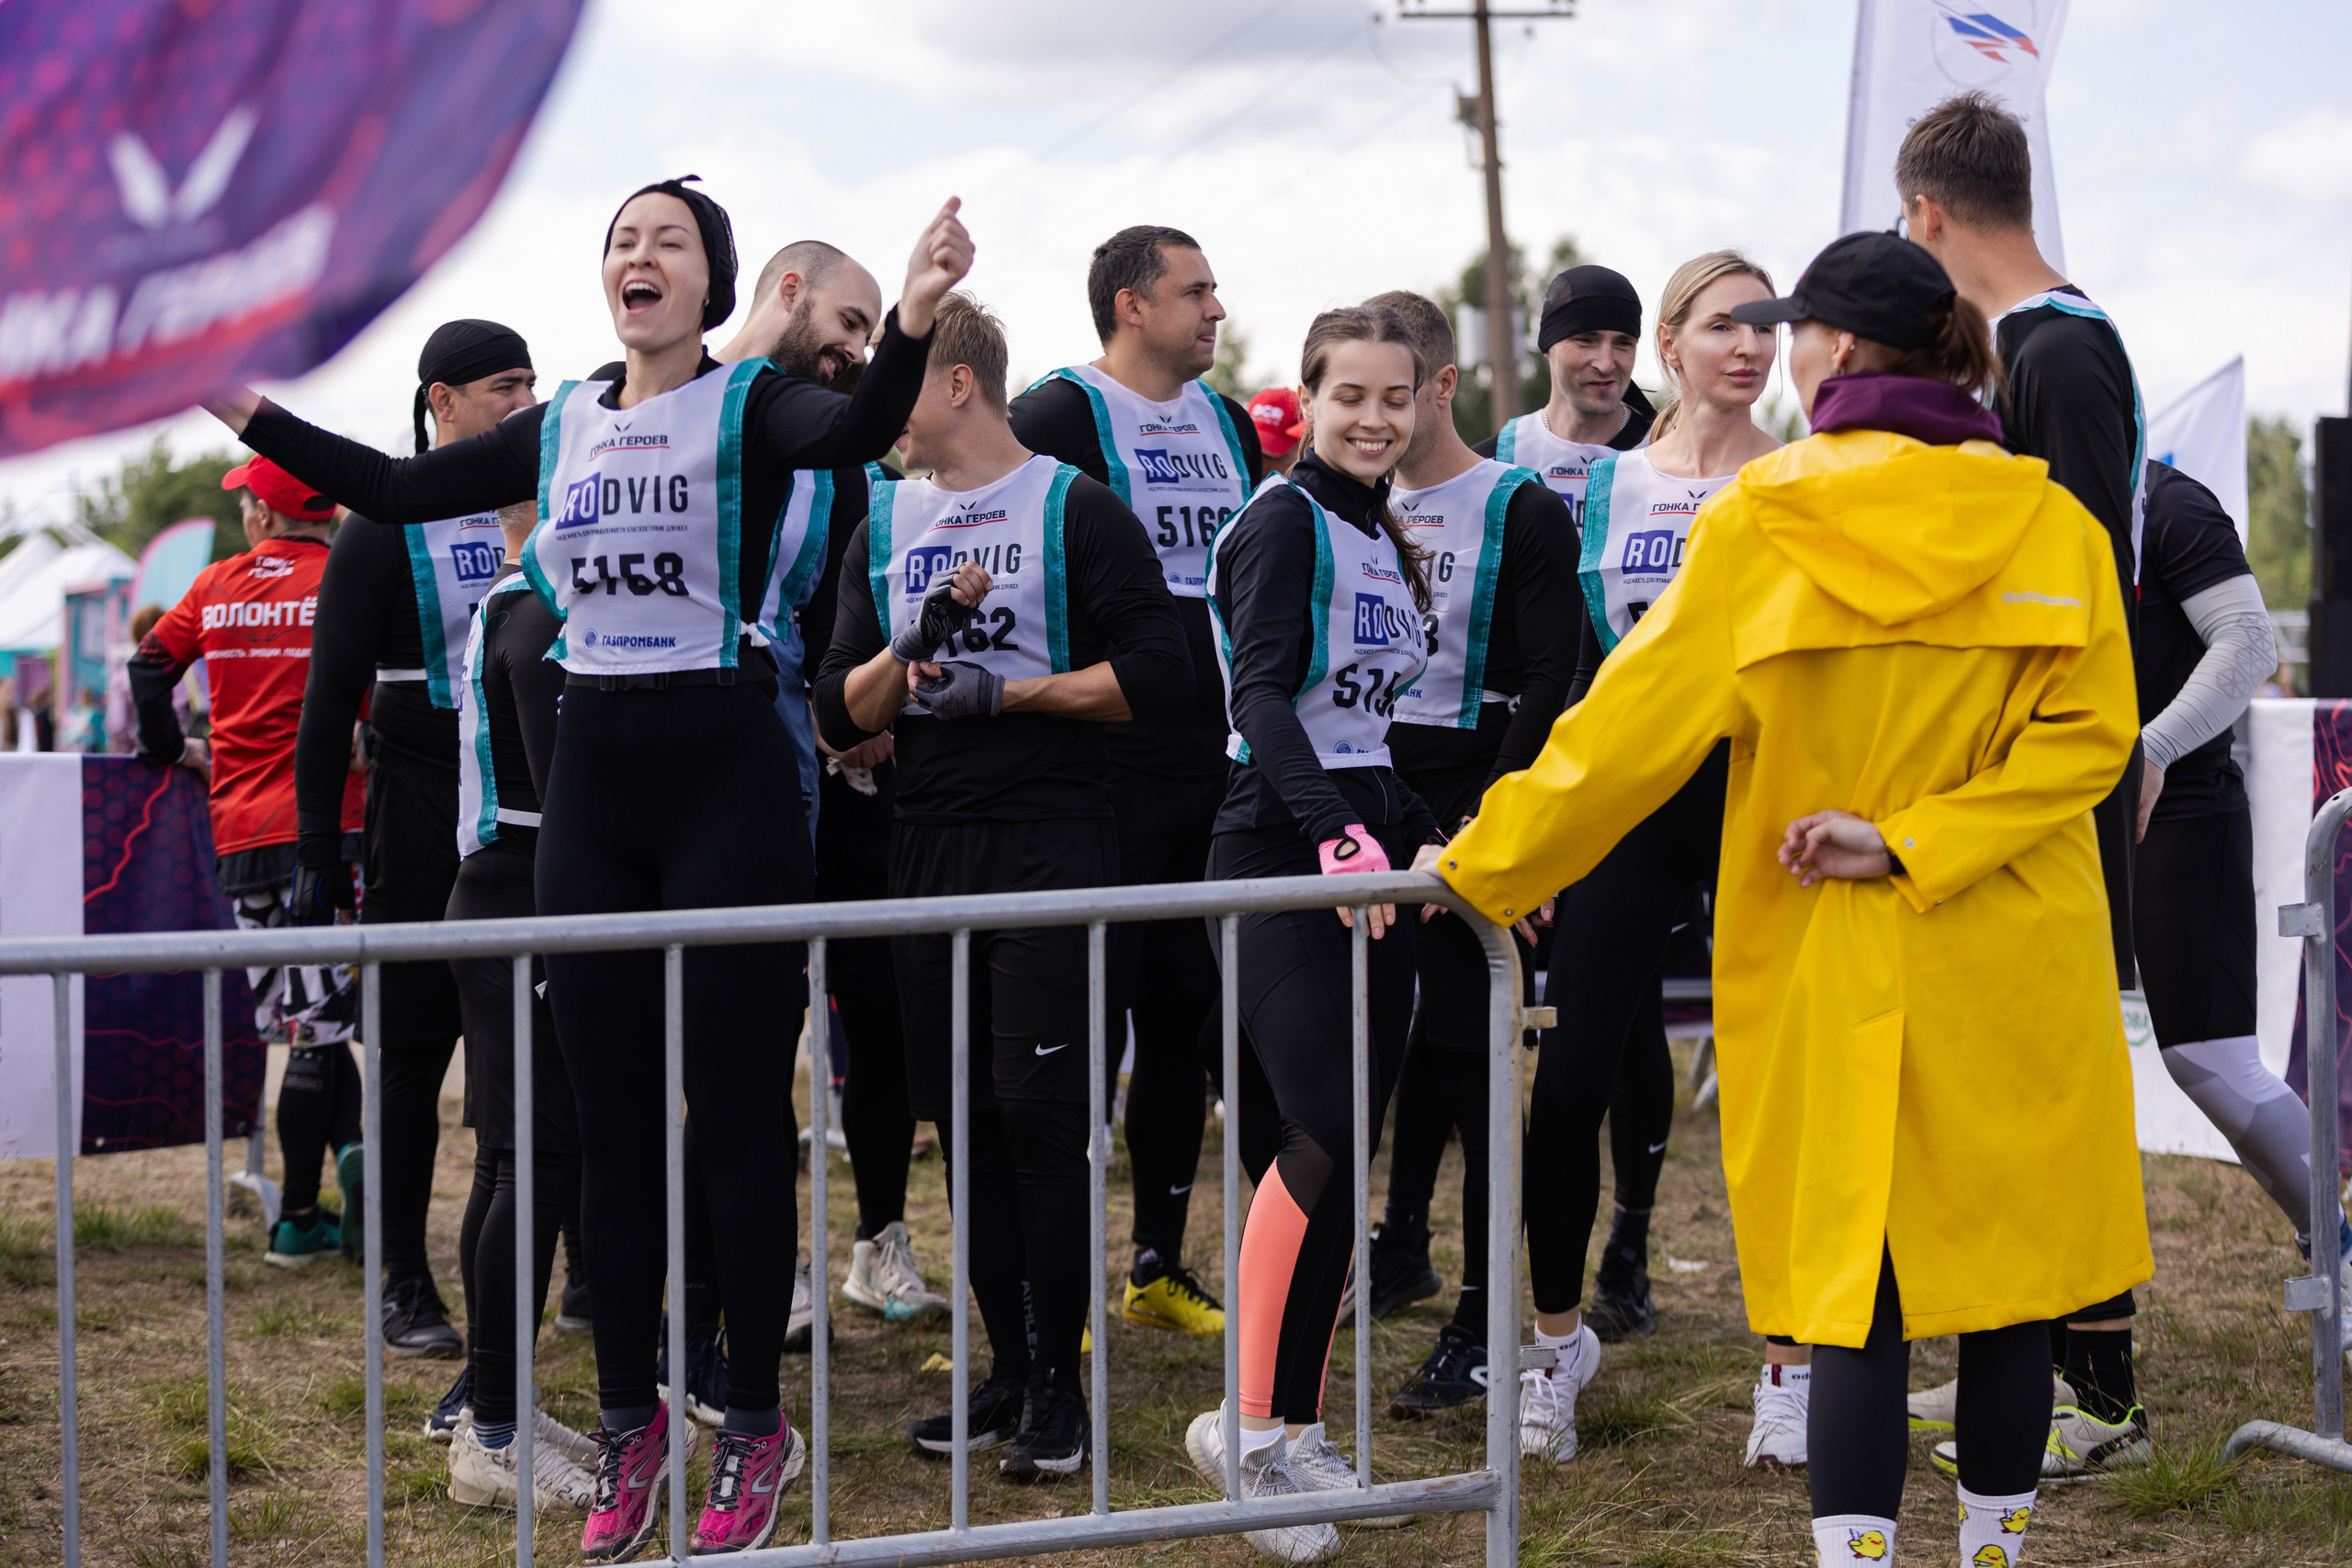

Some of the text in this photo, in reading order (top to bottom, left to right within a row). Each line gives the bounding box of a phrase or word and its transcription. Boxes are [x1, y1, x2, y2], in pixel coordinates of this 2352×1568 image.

[1140, 423, 1197, 433] ГОНКА ГЕРОЕВ
[590, 434, 668, 457] ГОНКА ГЕРОЕВ
[1138, 453, 1227, 479] RODVIG
[1551, 467, 1584, 476] ГОНКА
[559, 474, 688, 525] RODVIG
[1652, 502, 1690, 512] ГОНКА
[460, 517, 489, 527] ГОНКА
[931, 510, 1006, 530] ГОНКА ГЕРОЕВ
[1408, 515, 1444, 524] ГЕРОЕВ
[571, 552, 689, 596] 5158
[1358, 601, 1421, 649] RODVIG
[602, 635, 676, 649] ГАЗПРОМБАНК
[1332, 663, 1401, 721] 515
